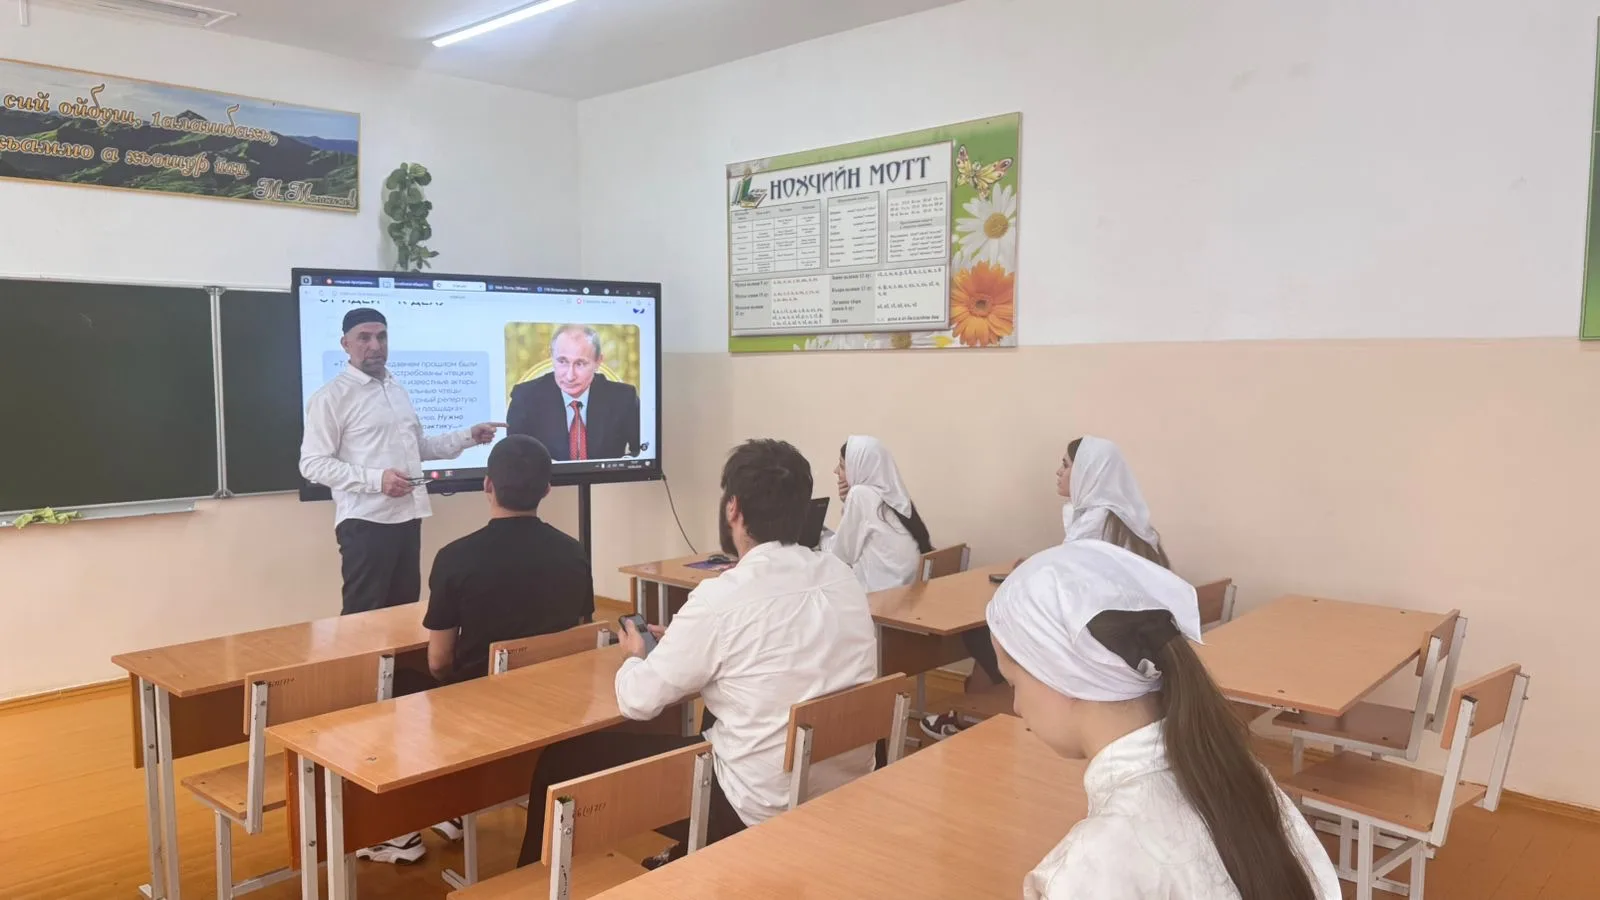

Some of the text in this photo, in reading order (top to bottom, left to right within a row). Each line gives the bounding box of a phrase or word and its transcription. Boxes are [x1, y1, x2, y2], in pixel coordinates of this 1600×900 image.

[3, 91, 50, 113] сий
[101, 147, 120, 163] а
[770, 155, 931, 200] НОХЧИЙН МОТТ
[437, 413, 464, 422] Нужно
